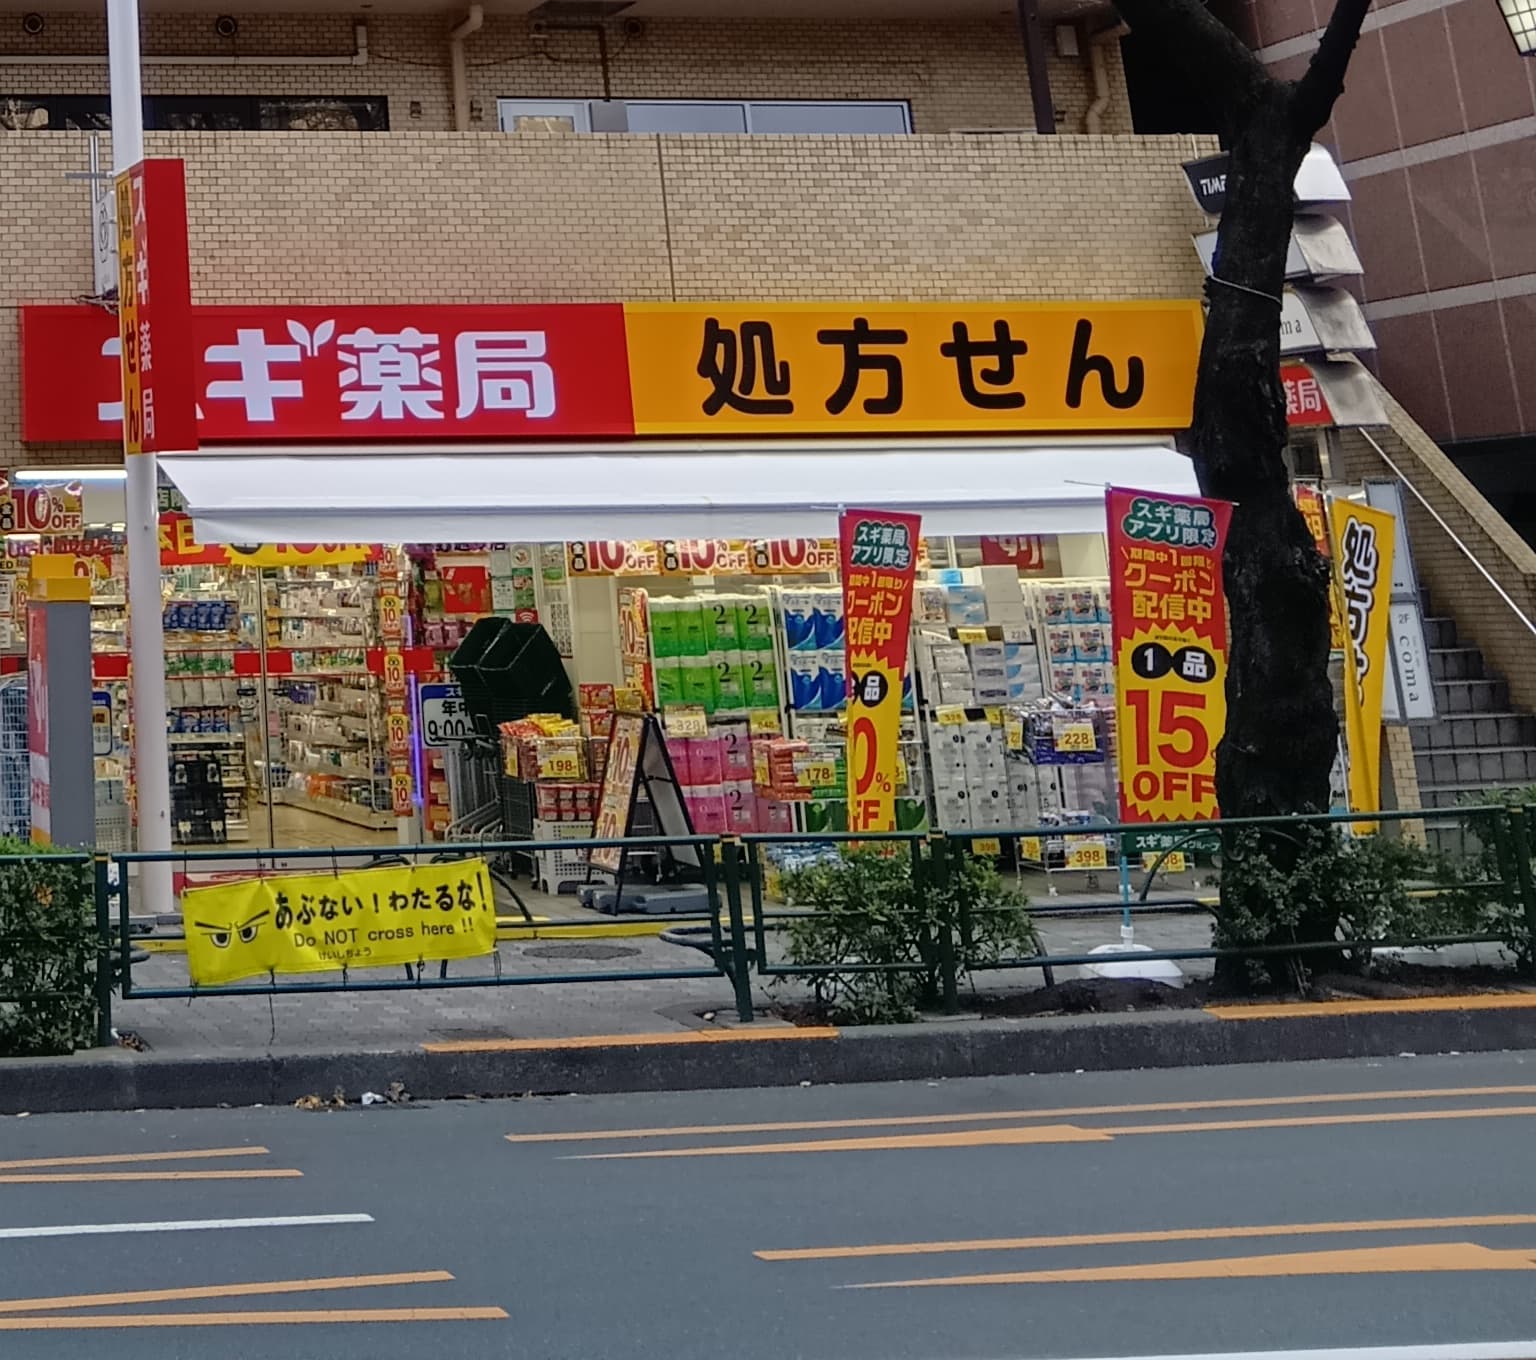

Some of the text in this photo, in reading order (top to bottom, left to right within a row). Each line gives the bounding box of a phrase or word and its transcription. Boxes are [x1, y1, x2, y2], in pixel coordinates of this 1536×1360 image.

[118, 184, 140, 444] 処方せん
[133, 176, 155, 440] スギ薬局
[697, 317, 1144, 415] 処方せん
[52, 514, 81, 529] OFF
[1136, 502, 1210, 527] スギ薬局
[858, 526, 906, 546] スギ薬局
[1128, 519, 1215, 547] アプリ限定
[625, 554, 656, 569] OFF
[715, 553, 748, 569] OFF
[806, 551, 835, 566] OFF
[850, 545, 911, 567] アプリ限定
[1124, 562, 1215, 596] クーポン
[714, 604, 726, 625] 2
[745, 604, 758, 625] 2
[1132, 589, 1212, 624] 配信中
[1398, 613, 1411, 624] 2F
[387, 667, 400, 681] 10
[717, 661, 731, 683] 2
[750, 660, 764, 681] 2
[1399, 635, 1420, 703] coma
[391, 727, 404, 742] 10
[1064, 732, 1089, 745] 228
[1125, 689, 1210, 769] 15
[724, 733, 739, 754] 2
[548, 759, 572, 772] 198
[805, 767, 830, 780] 178
[395, 787, 408, 800] 10
[1133, 770, 1216, 803] OFF
[729, 789, 743, 810] 2
[1076, 851, 1101, 863] 398
[294, 932, 317, 948] Do
[324, 928, 359, 946] NOT
[367, 925, 415, 942] cross
[421, 920, 455, 936] here
